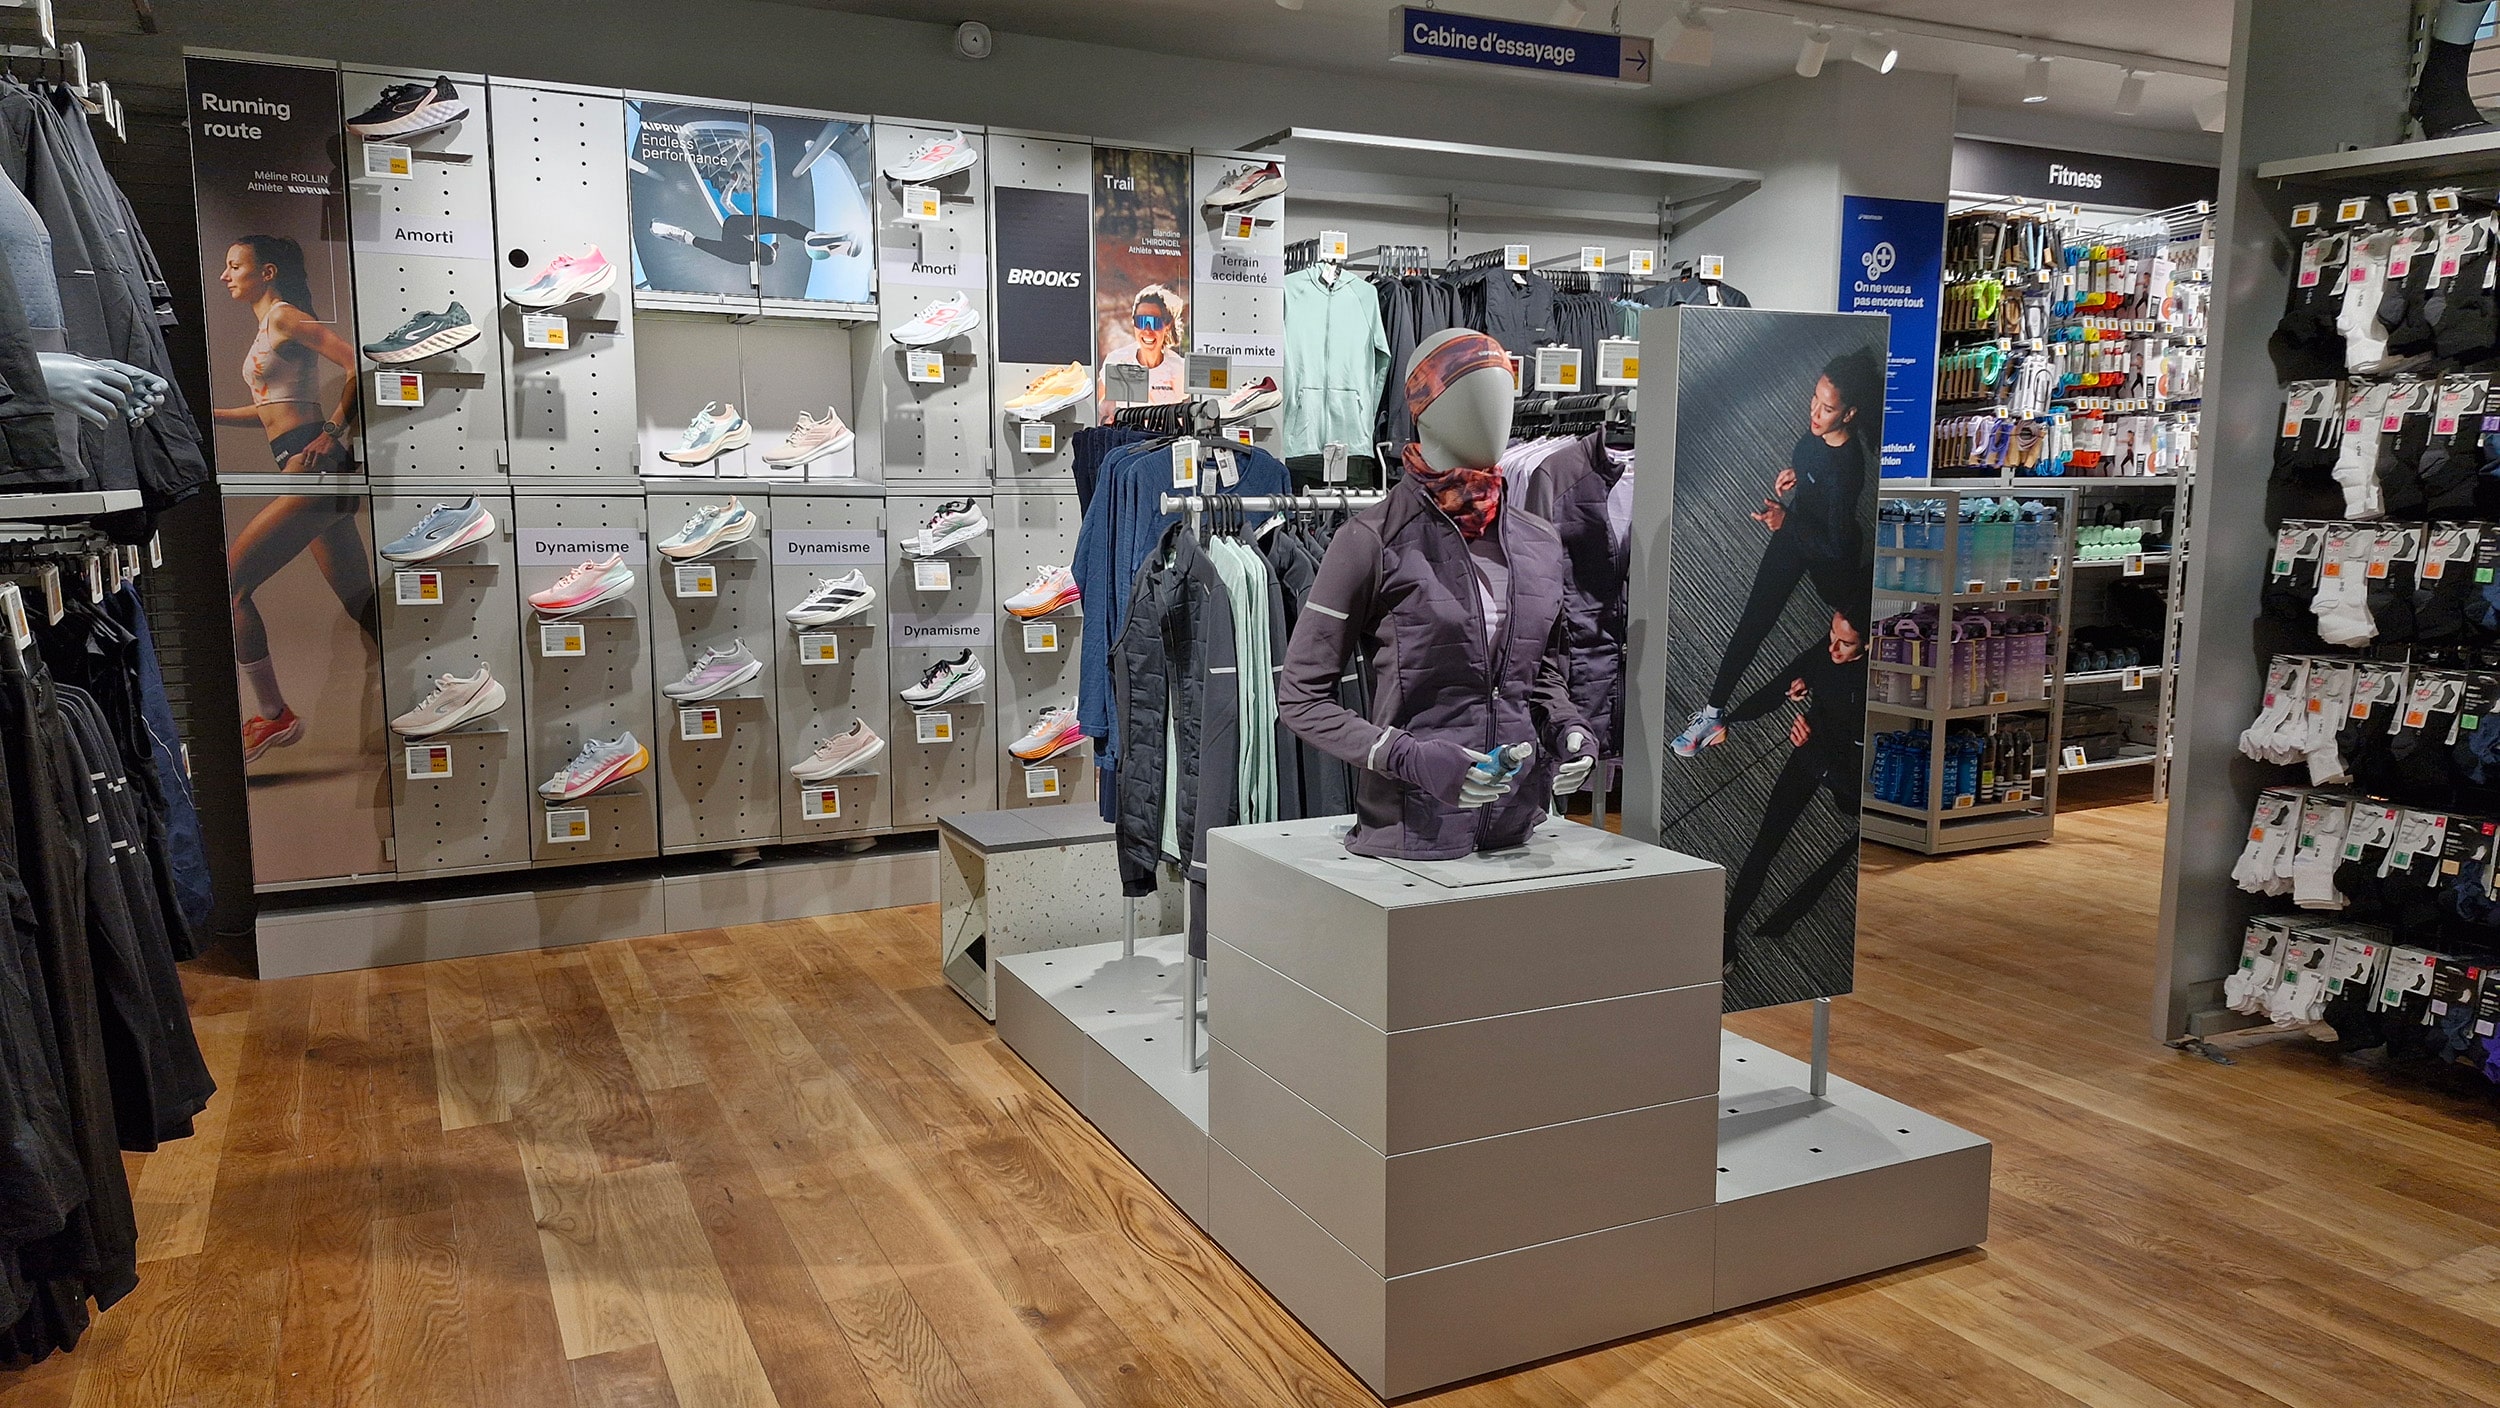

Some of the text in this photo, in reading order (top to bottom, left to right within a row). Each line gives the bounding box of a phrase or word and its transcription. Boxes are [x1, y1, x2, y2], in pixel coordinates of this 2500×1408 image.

[1412, 23, 1576, 66] Cabine d'essayage
[202, 93, 291, 121] Running
[204, 123, 262, 140] route
[641, 133, 694, 150] Endless
[642, 148, 728, 166] performance
[254, 170, 328, 184] Méline ROLLIN
[1104, 175, 1135, 191] Trail
[2049, 164, 2102, 189] Fitness
[247, 181, 283, 193] Athlète
[395, 227, 453, 244] Amorti
[1221, 255, 1259, 268] Terrain
[911, 262, 957, 276] Amorti
[1007, 268, 1082, 288] BROOKS
[1212, 271, 1268, 284] accidenté
[1854, 281, 1911, 294] On ne vous a
[1853, 297, 1924, 308] pas encore tout
[1203, 344, 1276, 357] Terrain mixte
[535, 541, 630, 554] Dynamisme
[788, 542, 870, 556] Dynamisme
[904, 624, 981, 639] Dynamisme
